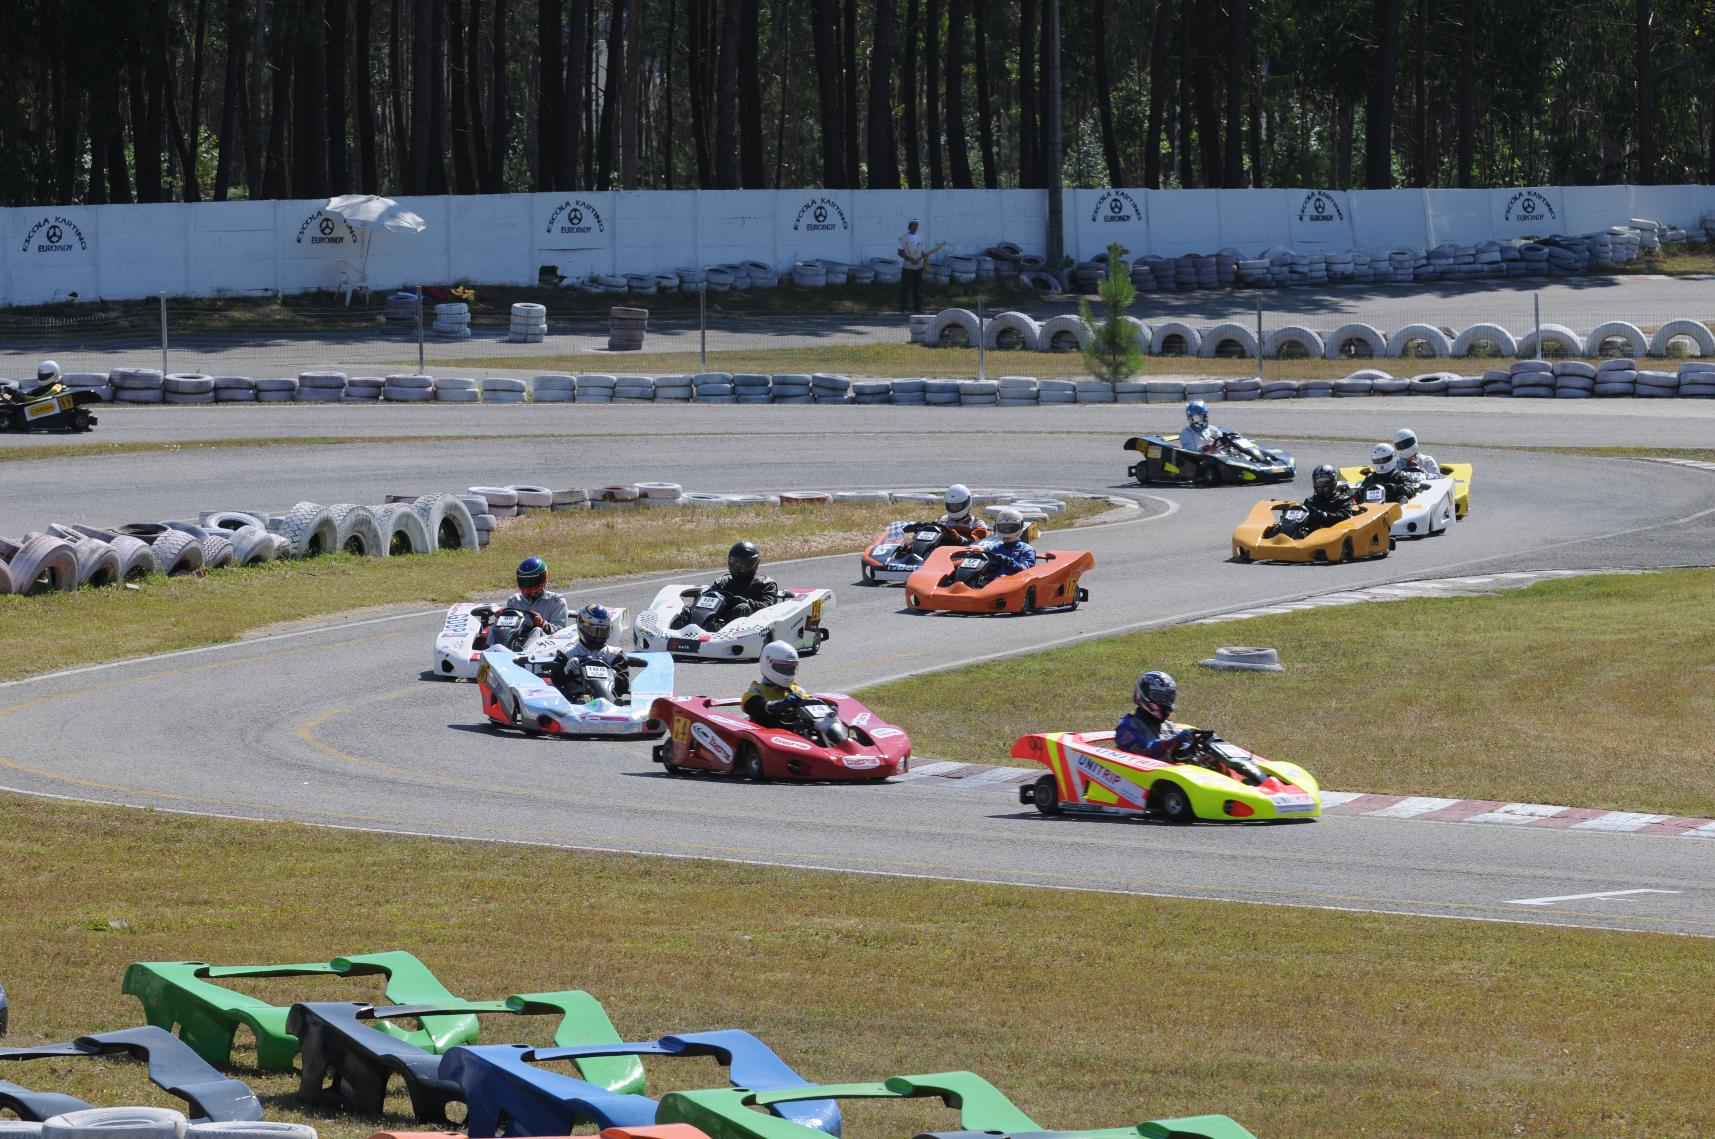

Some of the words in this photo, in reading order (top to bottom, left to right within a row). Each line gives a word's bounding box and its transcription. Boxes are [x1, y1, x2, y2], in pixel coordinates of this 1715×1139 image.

[546, 201, 571, 233] ESCOLA
[575, 199, 605, 232] KARTING
[793, 199, 817, 230] ESCOLA
[820, 197, 849, 230] KARTING
[1505, 192, 1523, 220] ESCOLA
[1527, 190, 1556, 220] KARTING
[22, 217, 49, 252] ESCOLA
[54, 215, 87, 251] KARTING
[296, 210, 322, 244] ESCOLA
[37, 244, 73, 252] EUROINDY
[1078, 755, 1121, 784] UNITRIP
